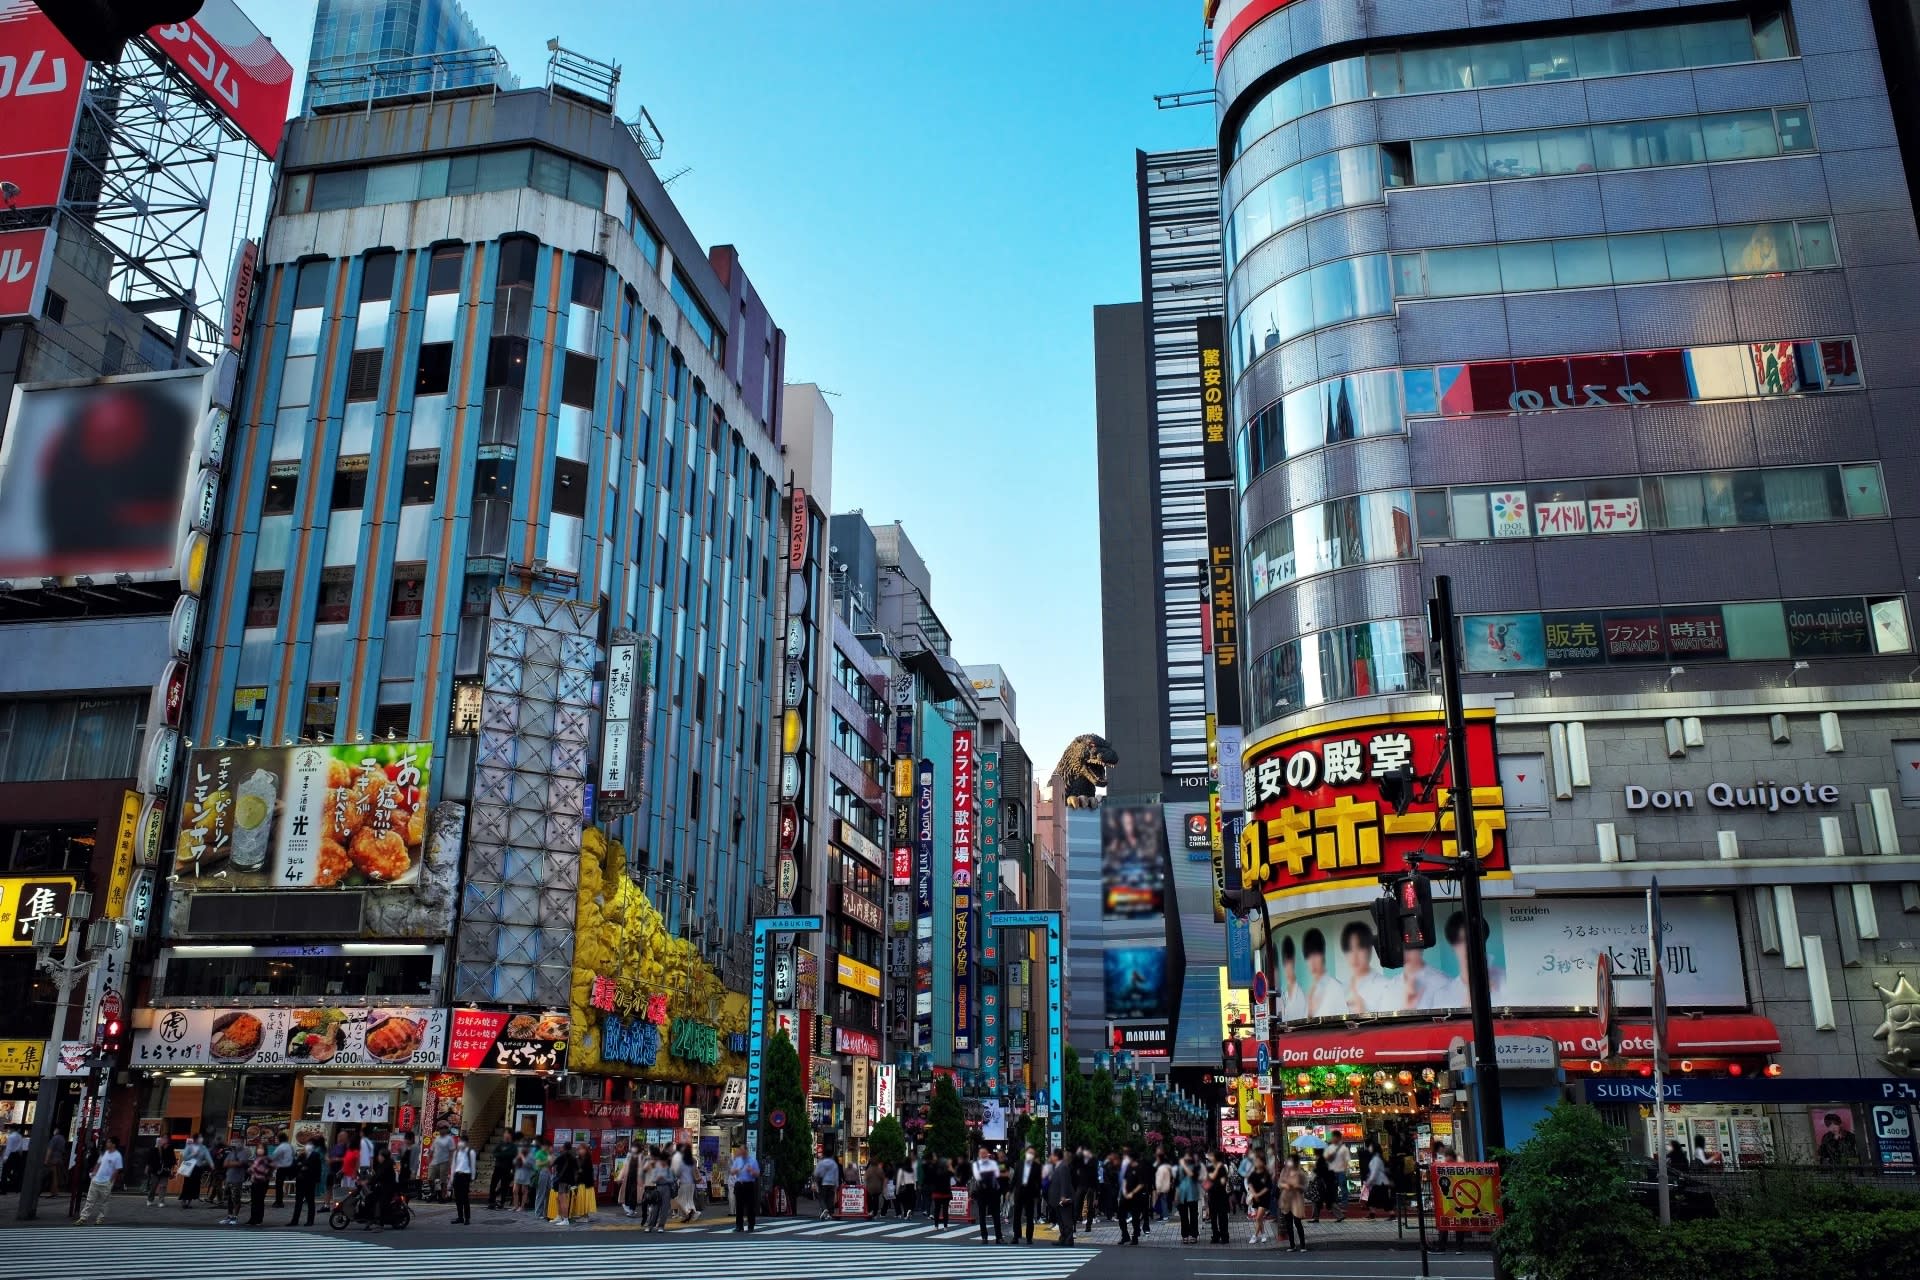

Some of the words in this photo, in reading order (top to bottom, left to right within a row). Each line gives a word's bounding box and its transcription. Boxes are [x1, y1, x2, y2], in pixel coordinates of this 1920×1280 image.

[1203, 348, 1224, 442] 驚安の殿堂
[1538, 505, 1586, 533] アイドル
[1591, 501, 1642, 530] ステージ
[1498, 529, 1526, 537] STAGE
[1502, 522, 1524, 530] IDOL
[1789, 607, 1864, 630] don.quijote
[1546, 622, 1597, 648] 販売
[1607, 625, 1659, 642] ブランド
[1670, 619, 1721, 638] 時計
[1610, 640, 1660, 654] BRAND
[1671, 637, 1722, 650] WATCH
[609, 768, 620, 781] 光
[1244, 733, 1414, 811] 驚安の殿堂
[355, 758, 378, 817] チキンが
[1624, 785, 1695, 810] Don
[1706, 780, 1840, 812] Quijote
[954, 736, 970, 864] カラオケ歌広場
[372, 784, 397, 840] 猛烈に
[190, 763, 212, 879] レモンサワー
[292, 815, 310, 837] 光
[284, 866, 304, 883] 4F
[1508, 905, 1551, 915] Torriden
[992, 915, 1028, 924] CENTRAL
[1029, 914, 1050, 923] ROAD
[1563, 922, 1674, 939] うるおいに、とびめ
[752, 945, 765, 1040] GODZILLA
[163, 1012, 185, 1041] 虎
[266, 1012, 275, 1031] そば
[456, 1016, 499, 1027] お好み焼き
[1049, 956, 1061, 1085] ゴジラロード
[276, 1011, 287, 1049] かき揚げ
[429, 1010, 443, 1049] かつ丼
[455, 1028, 497, 1039] もんじゃ焼き
[1125, 1029, 1166, 1042] MARUHAN
[140, 1043, 194, 1061] とらそば
[453, 1040, 488, 1050] 焼きそば
[496, 1040, 558, 1067] とらぢゅう
[554, 1041, 566, 1050] 2F
[1497, 1044, 1550, 1054] 心ステーション
[19, 1045, 39, 1072] 集
[256, 1052, 284, 1064] 580円
[334, 1051, 363, 1064] 600円
[412, 1051, 441, 1064] 590円
[452, 1051, 469, 1062] ピザ
[1282, 1048, 1308, 1063] Don
[1312, 1046, 1365, 1062] Quijote
[749, 1050, 763, 1100] ROAD
[1882, 1083, 1896, 1098] P
[327, 1102, 389, 1119] とらそば
[1875, 1110, 1893, 1136] P
